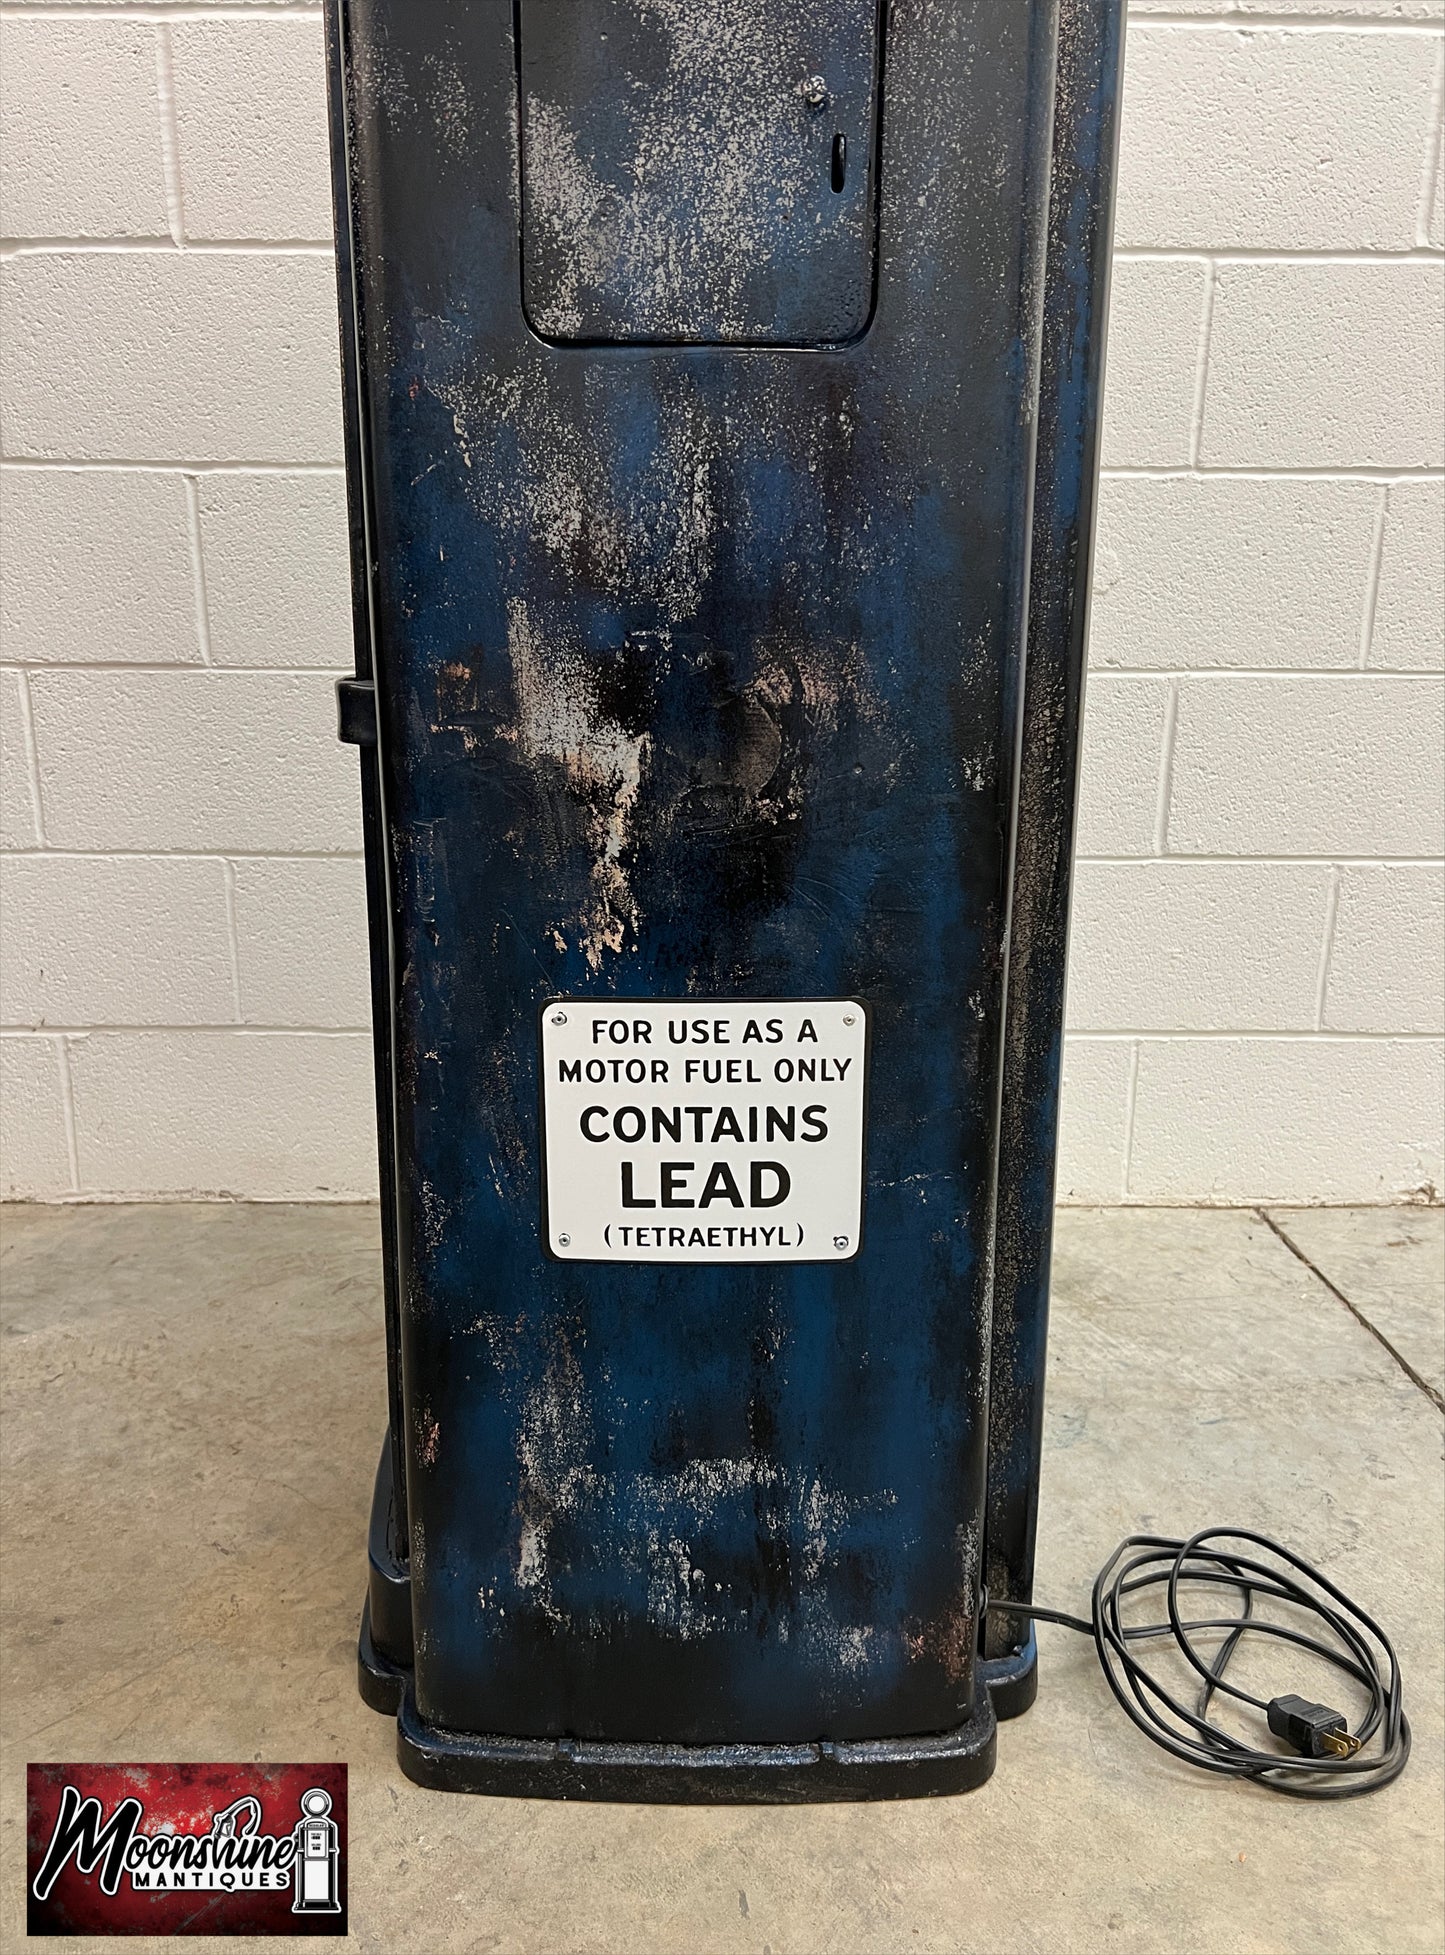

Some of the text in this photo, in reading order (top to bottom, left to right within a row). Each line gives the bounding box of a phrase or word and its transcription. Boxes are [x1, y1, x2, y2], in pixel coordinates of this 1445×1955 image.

[592, 1018, 818, 1045] FOR USE AS A
[558, 1057, 852, 1084] MOTOR FUEL ONLY
[579, 1104, 829, 1143] CONTAINS
[620, 1160, 792, 1209] LEAD
[603, 1222, 805, 1249] (TETRAETHYL)
